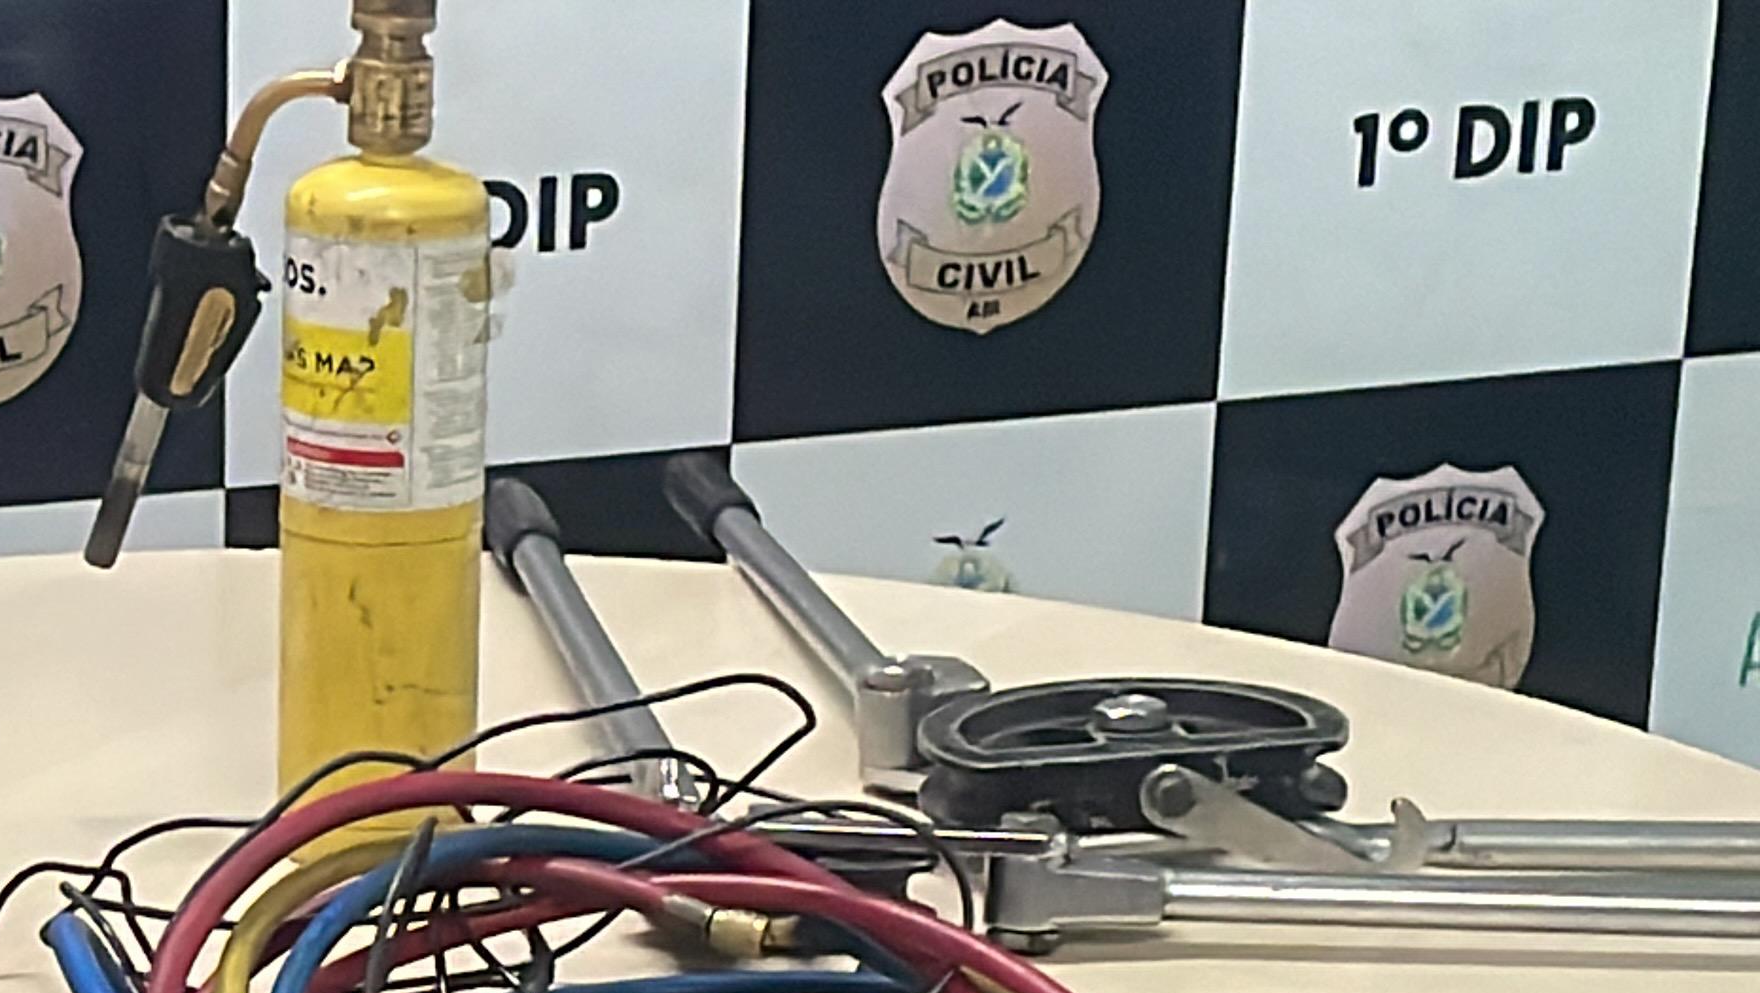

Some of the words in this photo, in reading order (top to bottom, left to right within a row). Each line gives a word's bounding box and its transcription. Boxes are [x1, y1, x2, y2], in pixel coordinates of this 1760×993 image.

[926, 50, 1072, 98] POLÍCIA
[1454, 97, 1596, 179] DIP
[483, 173, 620, 252] DIP
[937, 254, 1041, 291] CIVIL
[1376, 488, 1508, 538] POLÍCIA
